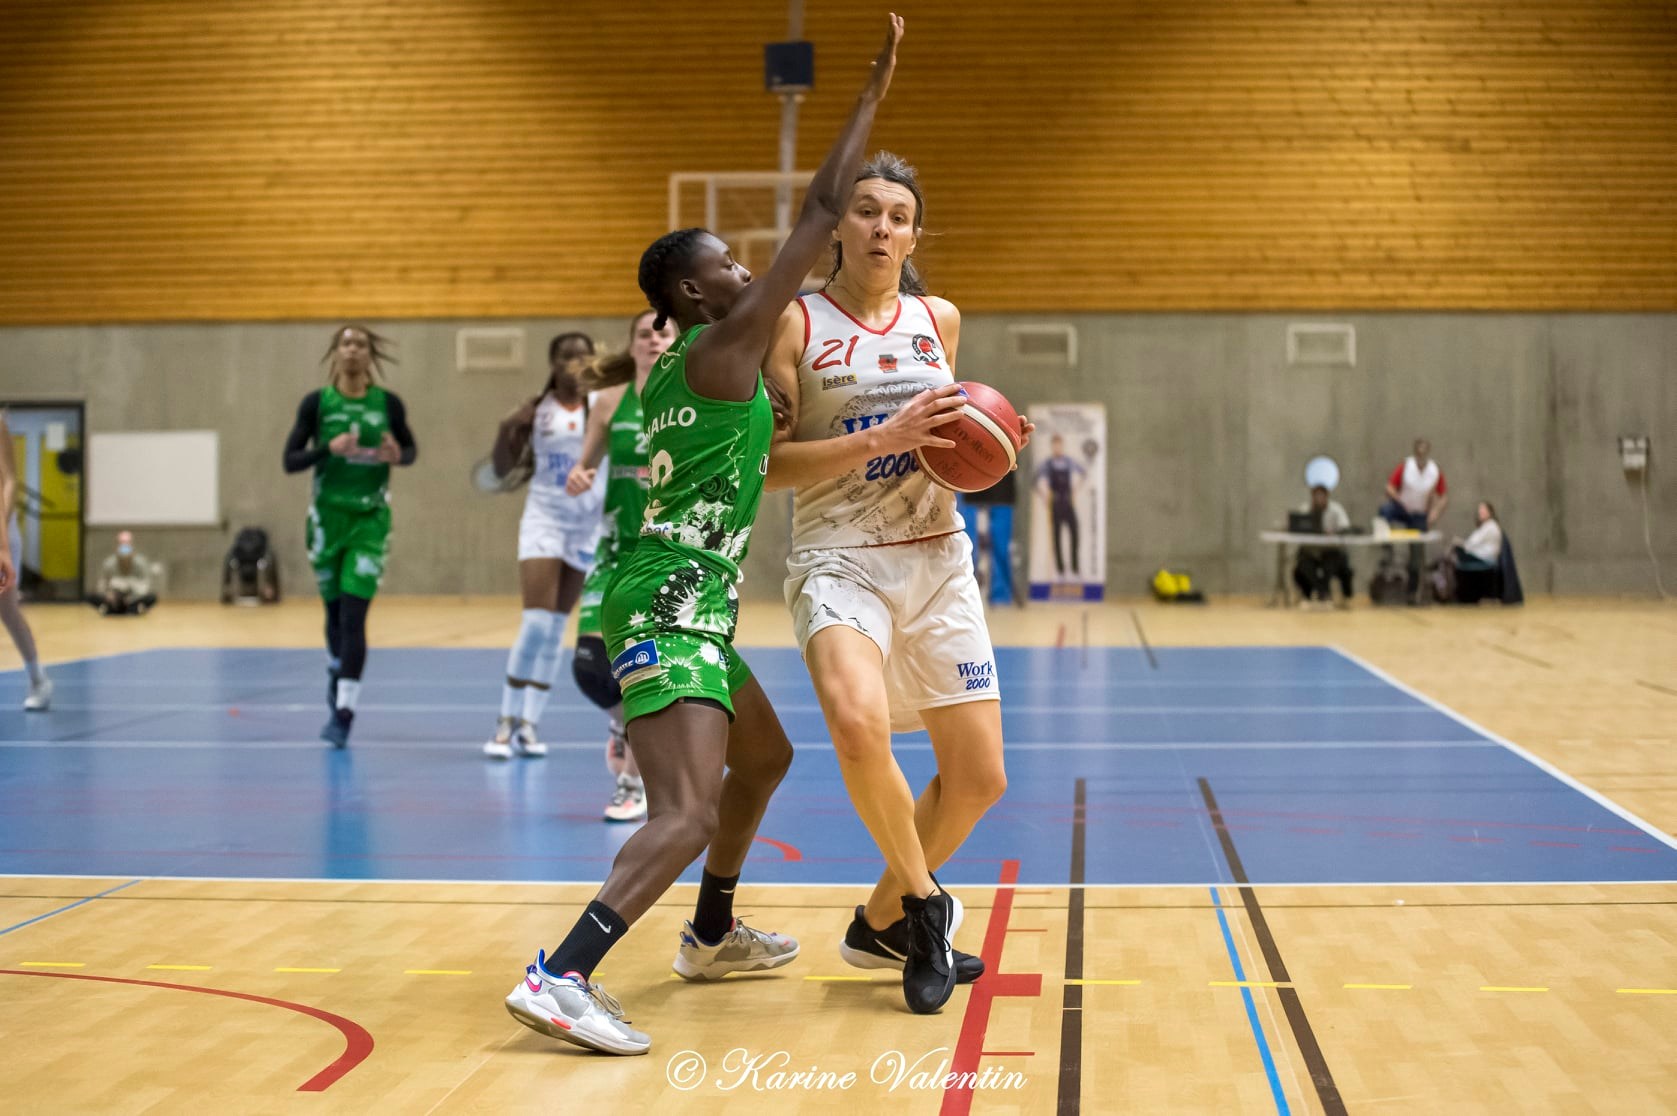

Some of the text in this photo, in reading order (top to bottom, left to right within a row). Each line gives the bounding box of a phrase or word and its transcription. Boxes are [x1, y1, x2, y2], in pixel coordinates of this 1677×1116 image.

[812, 335, 860, 371] 21
[956, 660, 995, 678] Work
[966, 677, 991, 690] 2000
